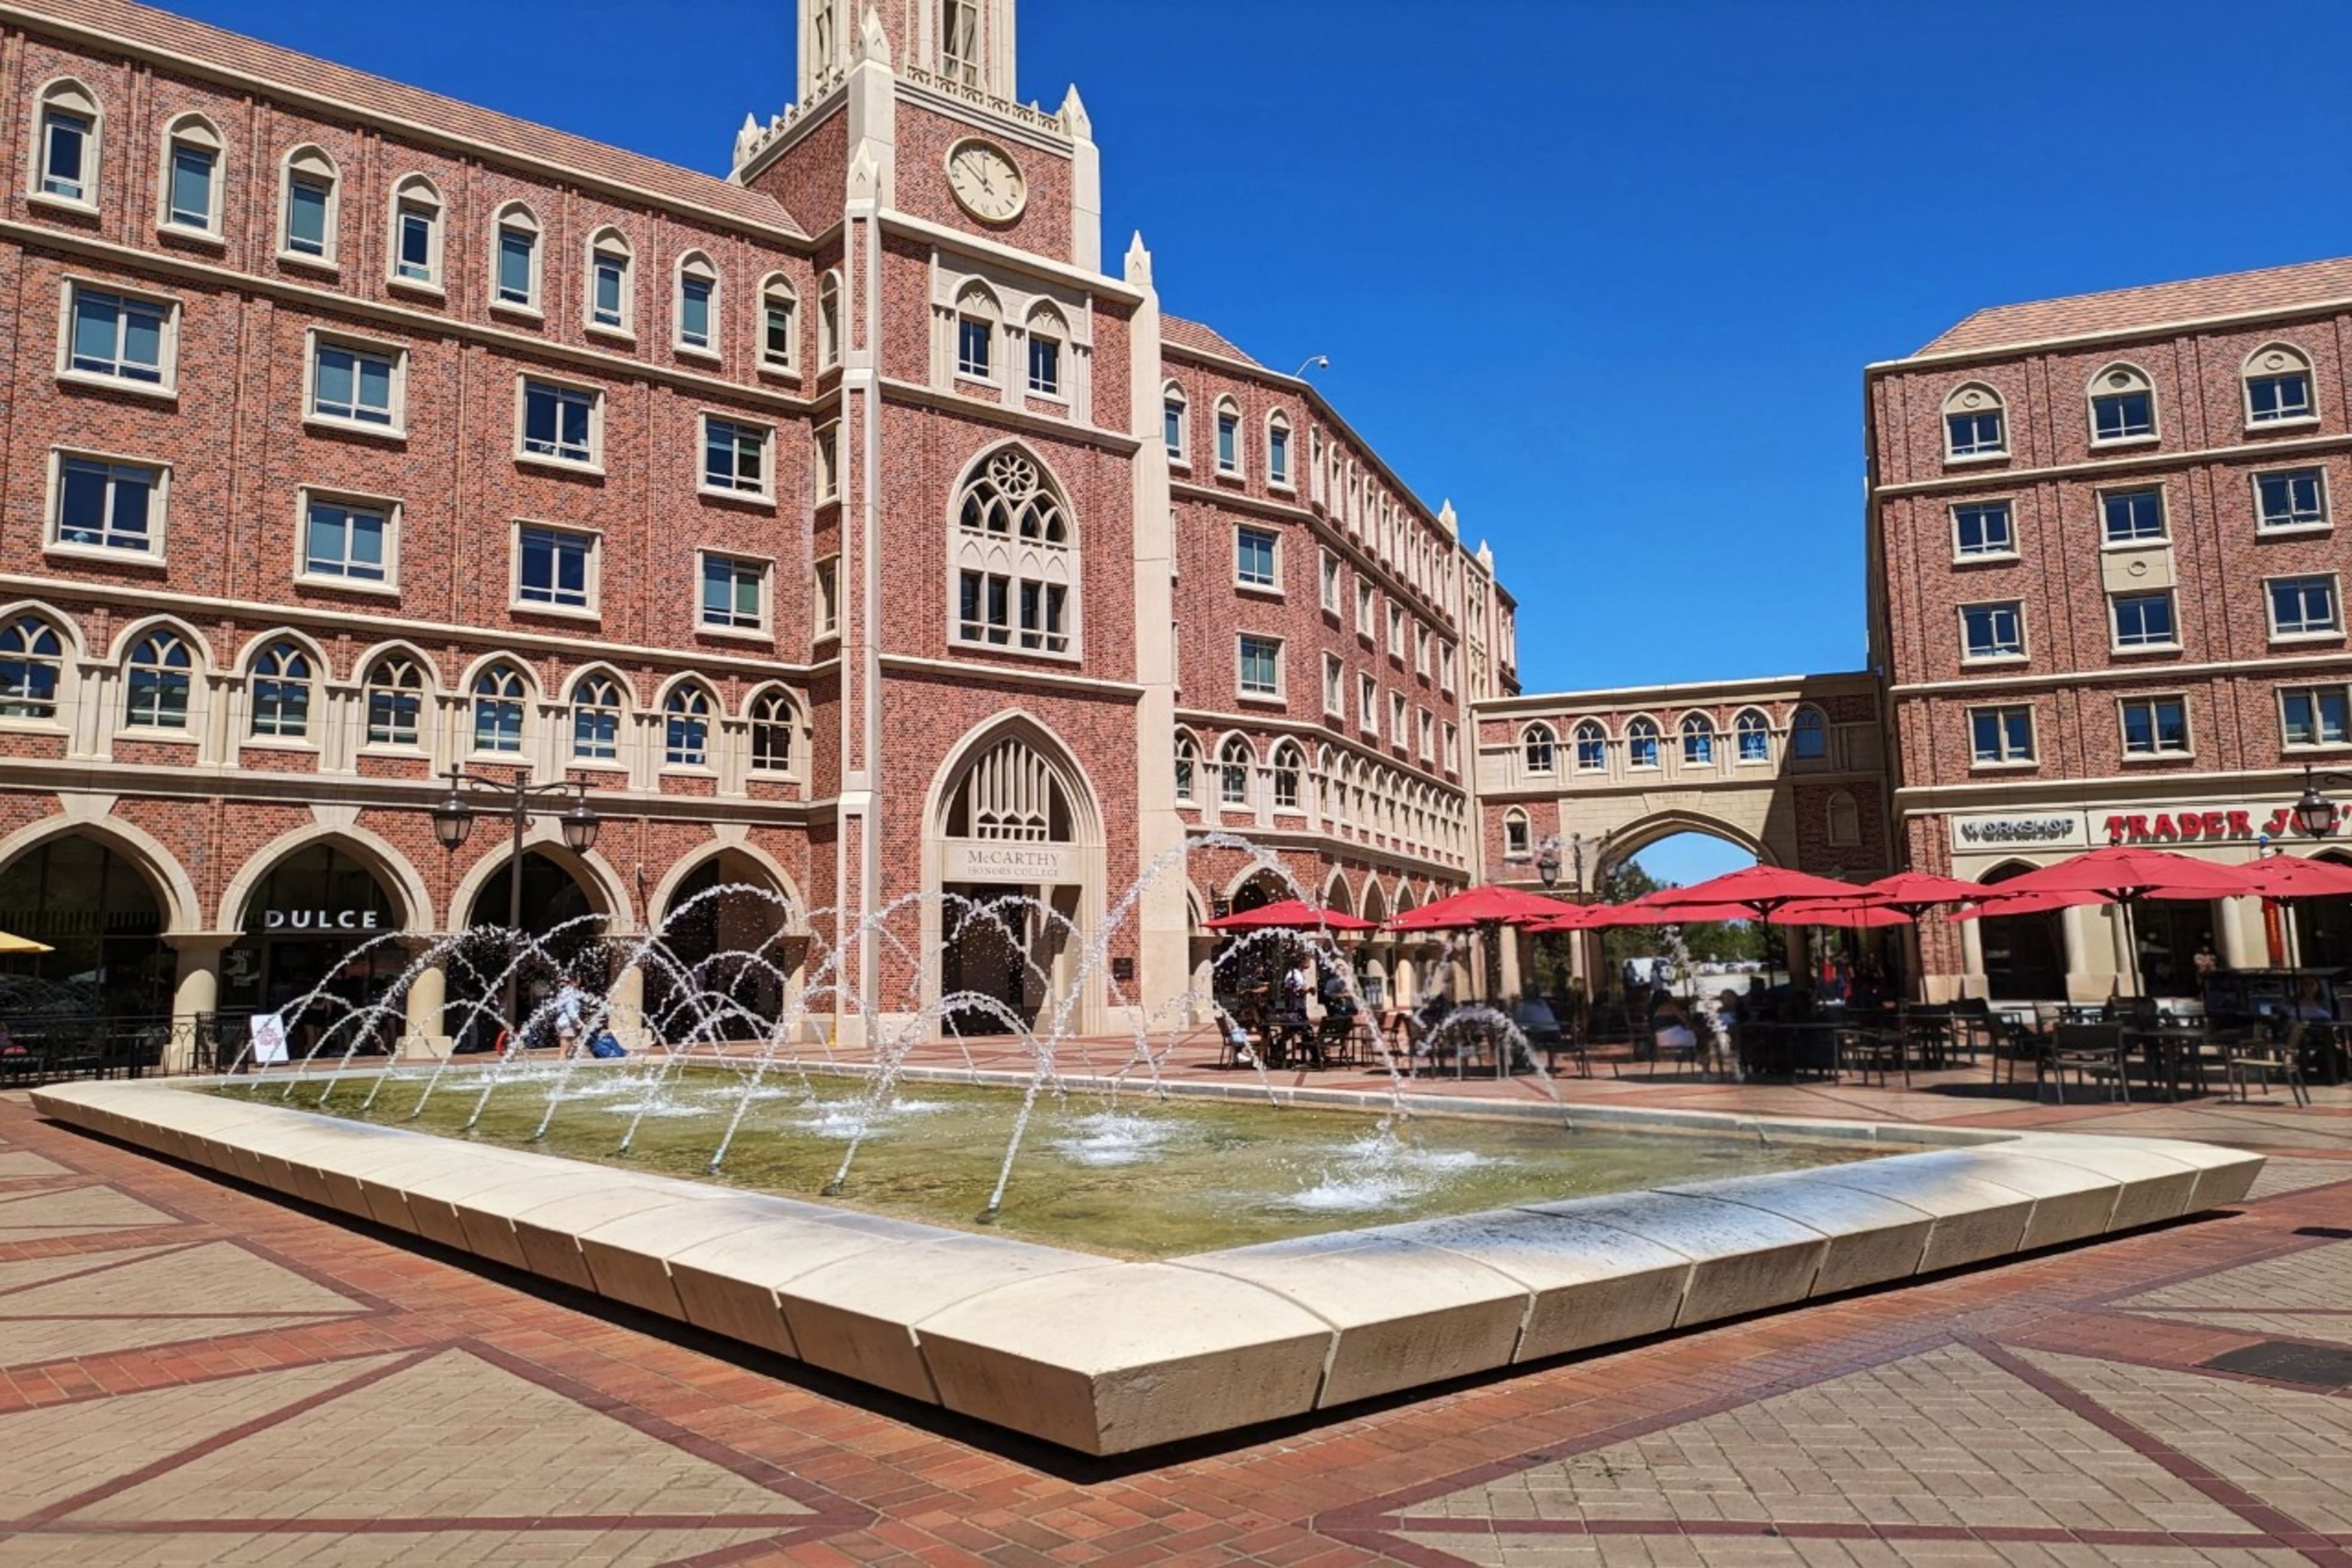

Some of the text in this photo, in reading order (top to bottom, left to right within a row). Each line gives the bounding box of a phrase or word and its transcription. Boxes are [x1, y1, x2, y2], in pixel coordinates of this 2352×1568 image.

[1962, 819, 2074, 838] WORKSHOP
[2105, 810, 2253, 839] TRADER
[968, 866, 1059, 877] HONORS COLLEGE
[264, 910, 378, 928] DULCE
